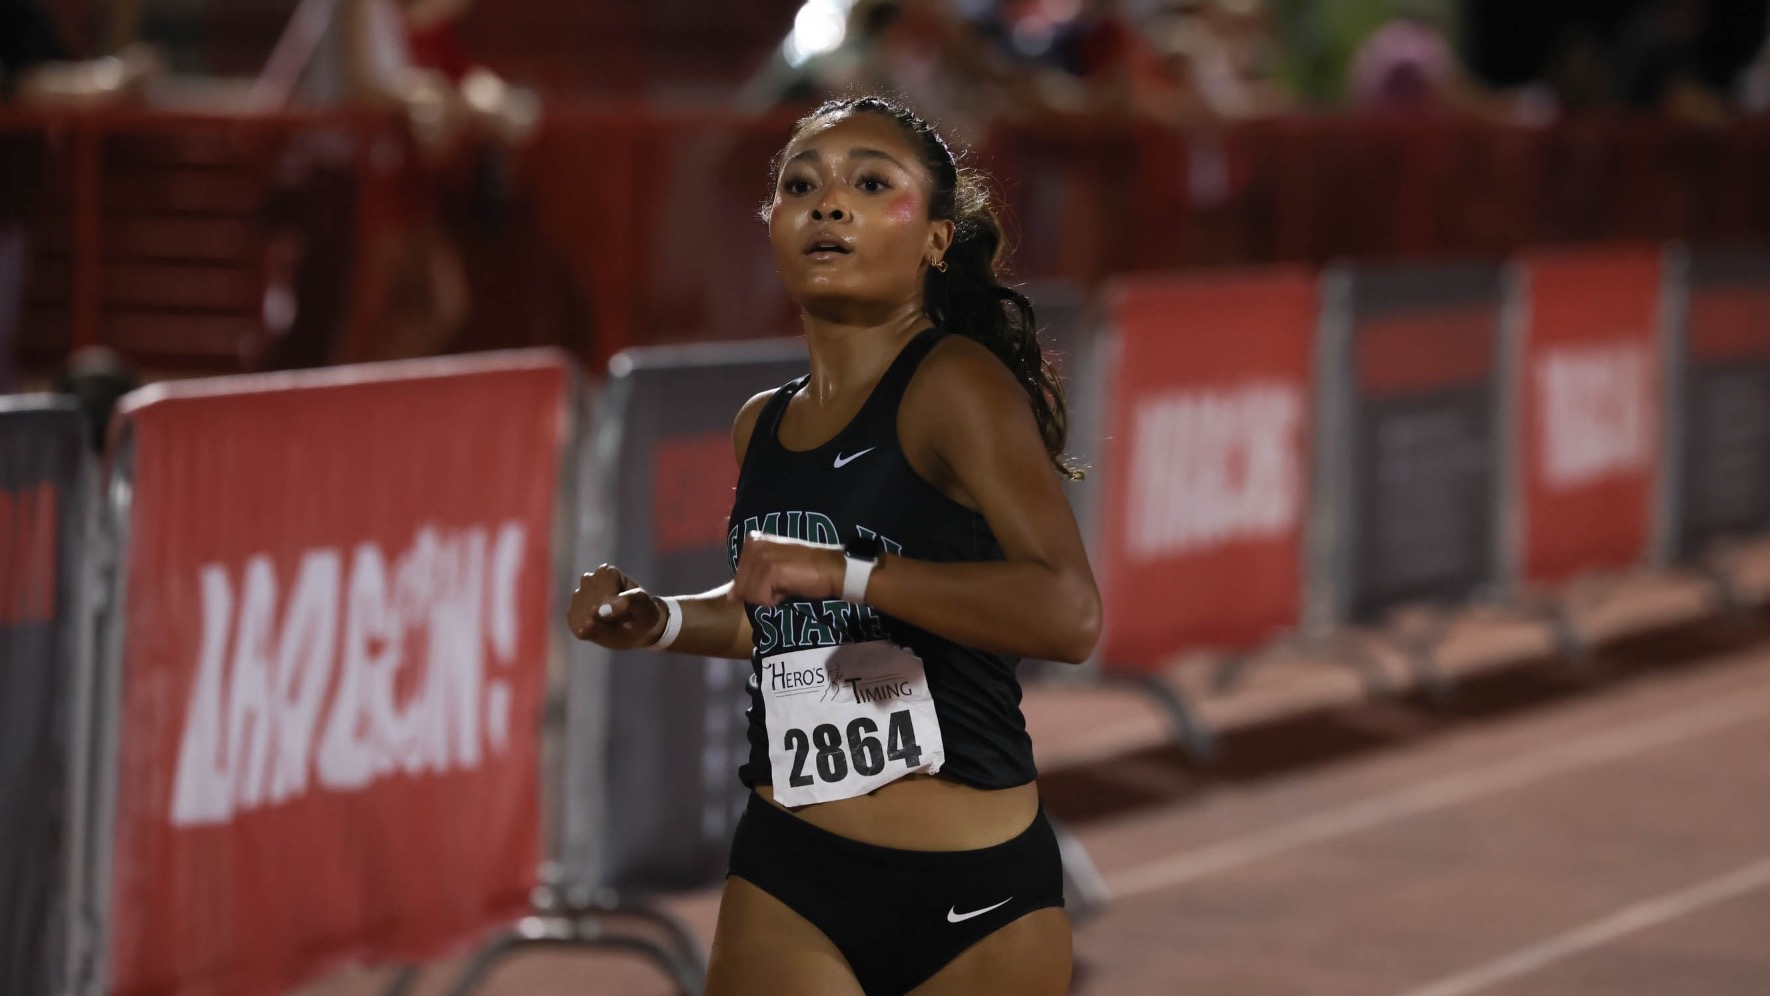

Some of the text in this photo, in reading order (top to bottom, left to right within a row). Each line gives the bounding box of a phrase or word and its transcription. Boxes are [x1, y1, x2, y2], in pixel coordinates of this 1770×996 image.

[754, 600, 891, 654] STATE
[845, 677, 912, 704] TIMING
[784, 709, 923, 788] 2864
